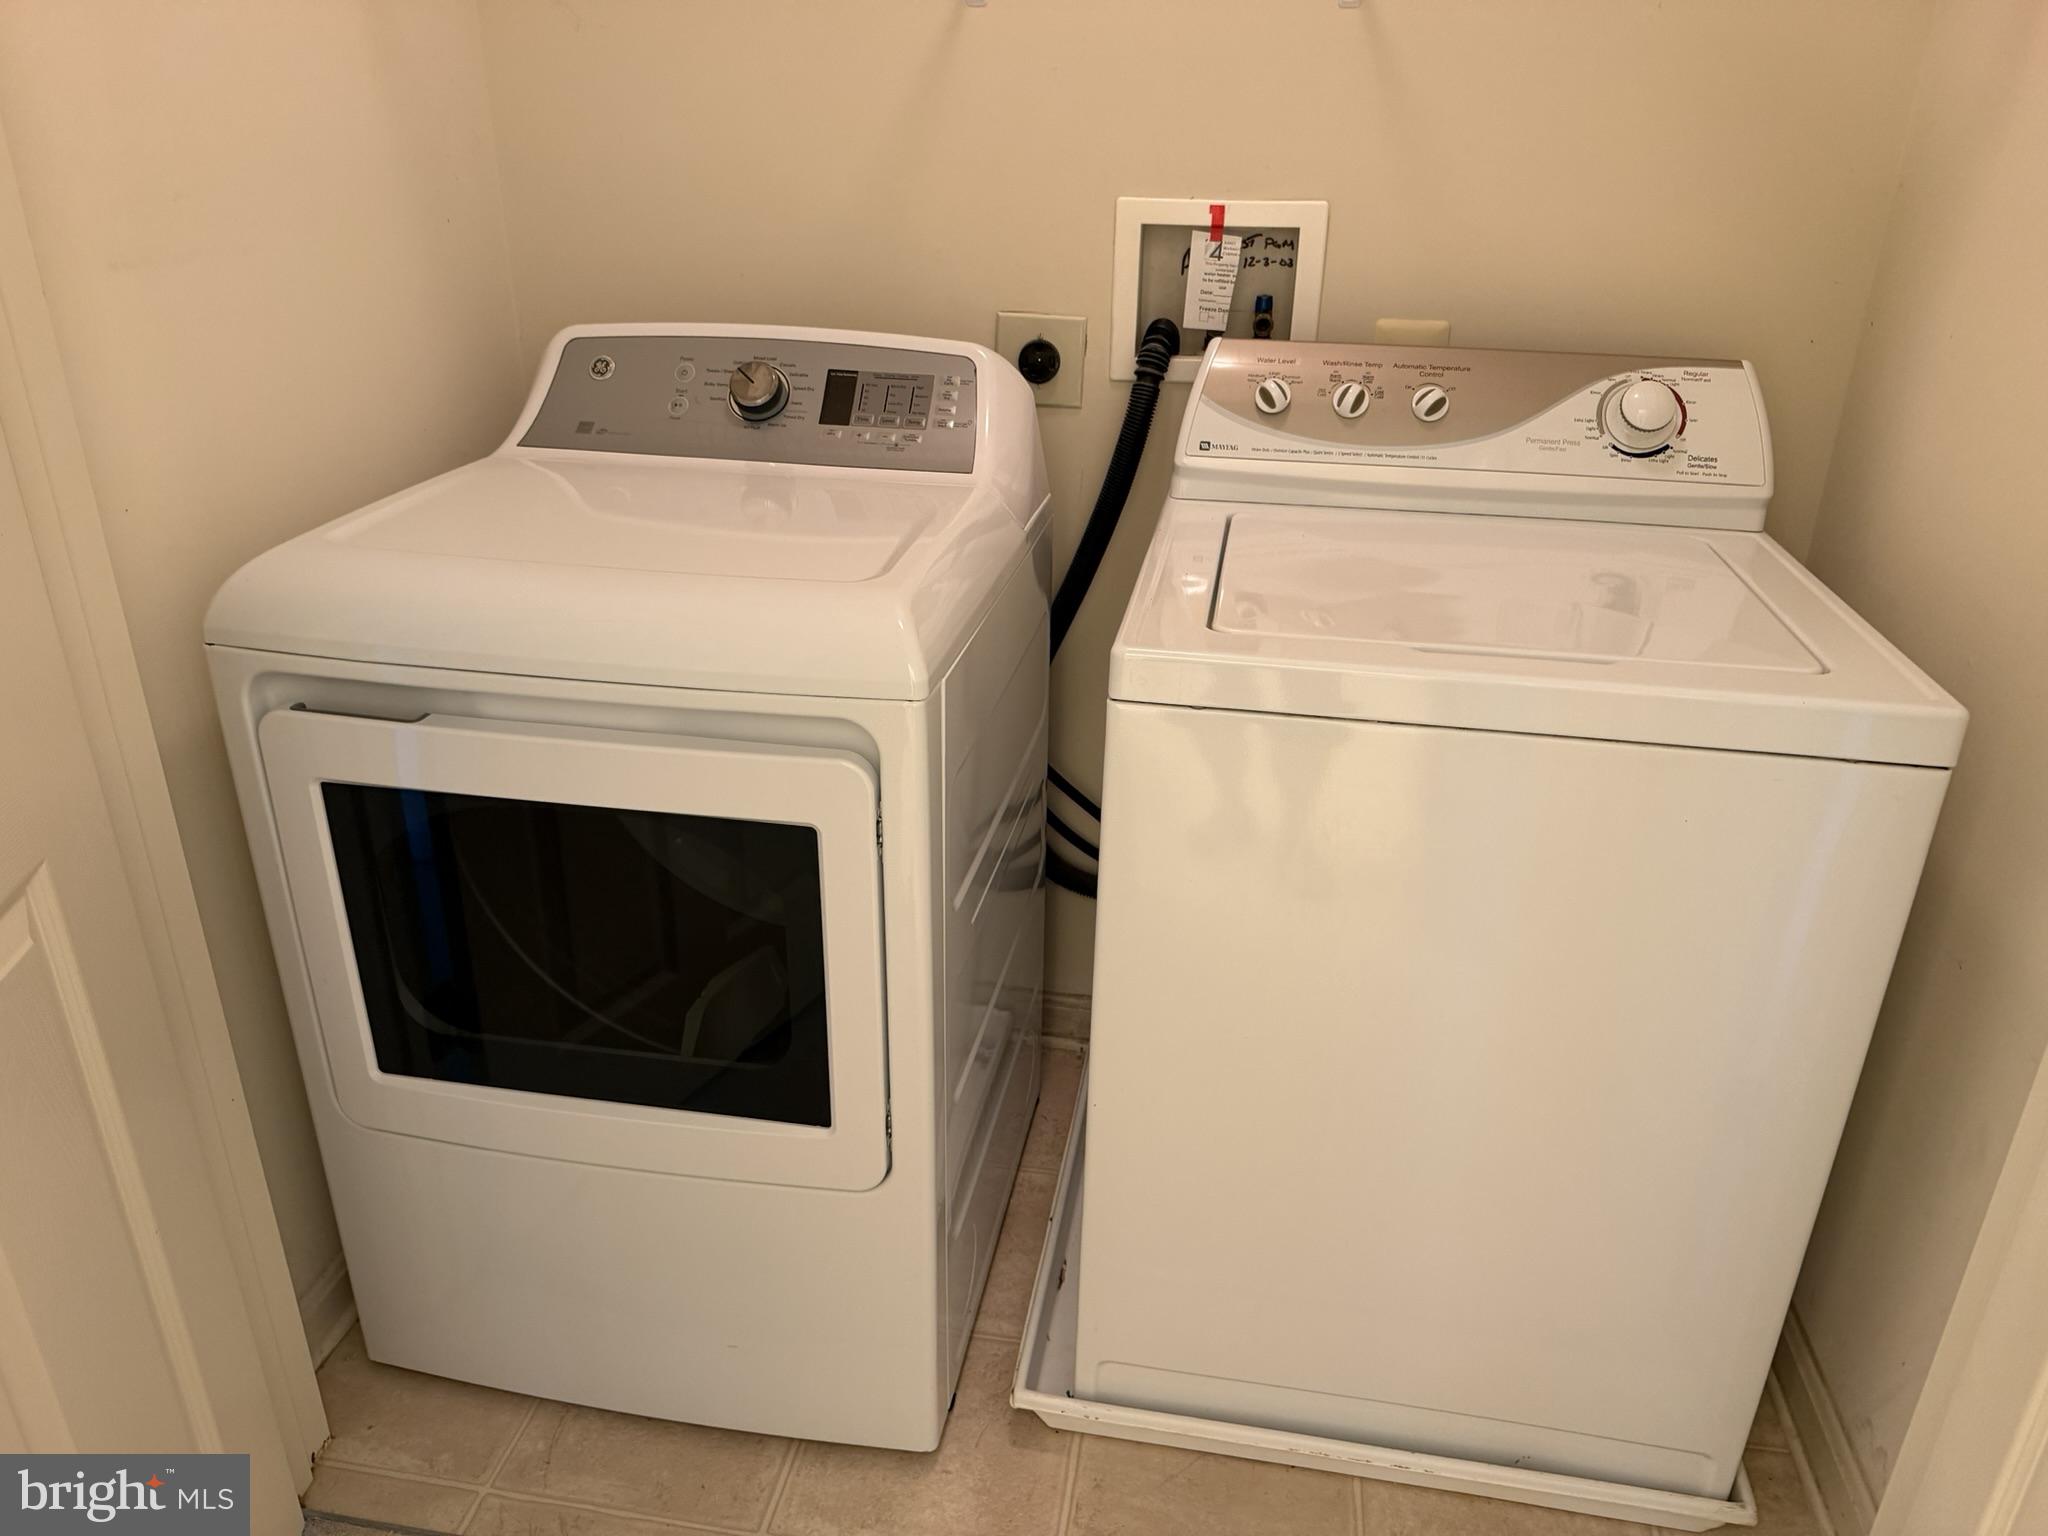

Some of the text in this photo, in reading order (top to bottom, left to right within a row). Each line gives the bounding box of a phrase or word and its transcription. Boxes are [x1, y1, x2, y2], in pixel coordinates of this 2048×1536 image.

[1243, 256, 1294, 269] 12-3-03
[1199, 305, 1217, 313] Freeze
[1322, 360, 1384, 370] Wash/Rinse Temp
[1393, 362, 1471, 373] Automatic Temperature
[1683, 370, 1709, 379] Regular
[1212, 443, 1239, 451] MAYTAG
[1526, 438, 1582, 447] Permanent Press
[1688, 454, 1719, 463] Delicates
[1687, 462, 1718, 470] Gentle/Slow
